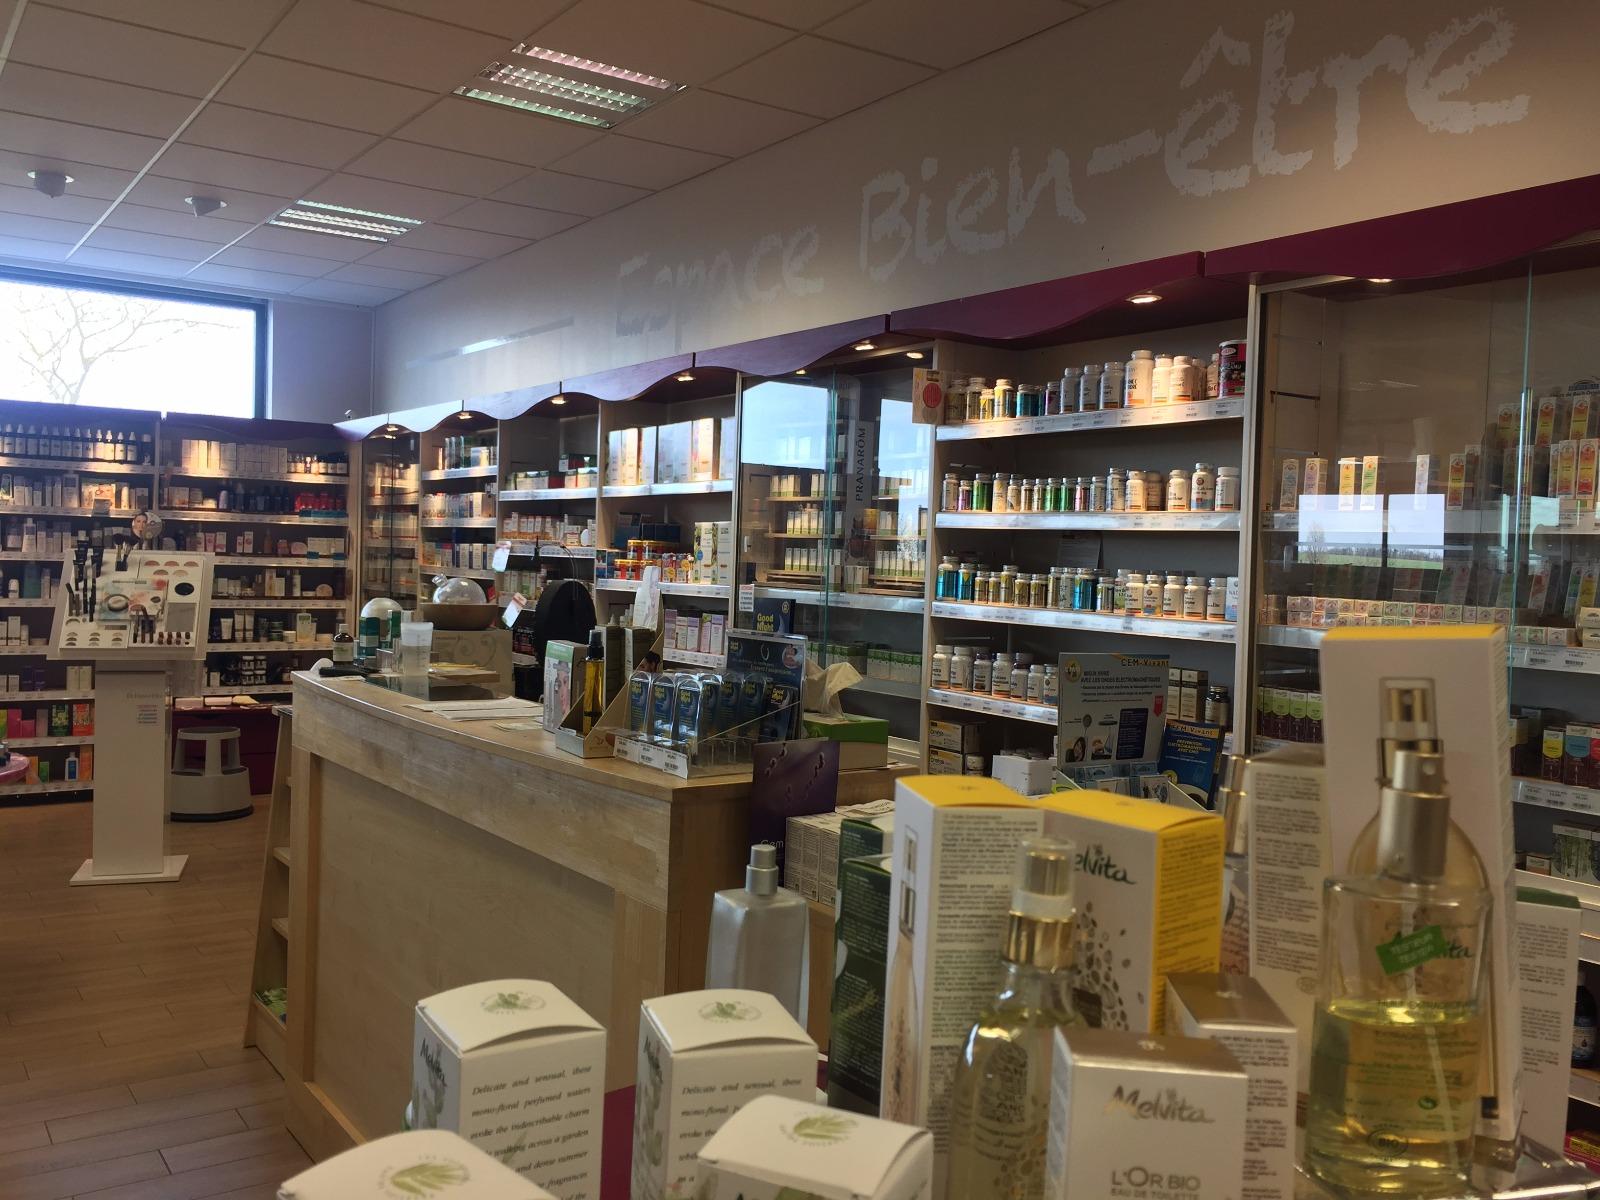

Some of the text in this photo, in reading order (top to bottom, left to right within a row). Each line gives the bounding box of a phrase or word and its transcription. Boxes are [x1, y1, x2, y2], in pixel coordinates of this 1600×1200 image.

[858, 7, 1531, 282] Bien-être
[856, 427, 866, 502] PRANARÔM
[757, 613, 774, 622] Good
[757, 622, 774, 632] Night
[472, 1083, 507, 1096] Delicate
[512, 1077, 529, 1088] and
[572, 1065, 592, 1075] these
[682, 1085, 716, 1095] Delicate
[721, 1082, 739, 1092] and
[472, 1087, 591, 1117] mono-floral perfumed waters
[1104, 1085, 1216, 1124] Melvita
[496, 1125, 508, 1135] the
[564, 1108, 590, 1119] charm
[528, 1138, 553, 1149] across
[561, 1129, 589, 1144] garden
[533, 1159, 556, 1170] dense
[558, 1151, 588, 1163] summer
[547, 1172, 588, 1189] fragrances
[1168, 1175, 1201, 1191] BIO
[1111, 1188, 1200, 1200] EAU DE TOILETTE
